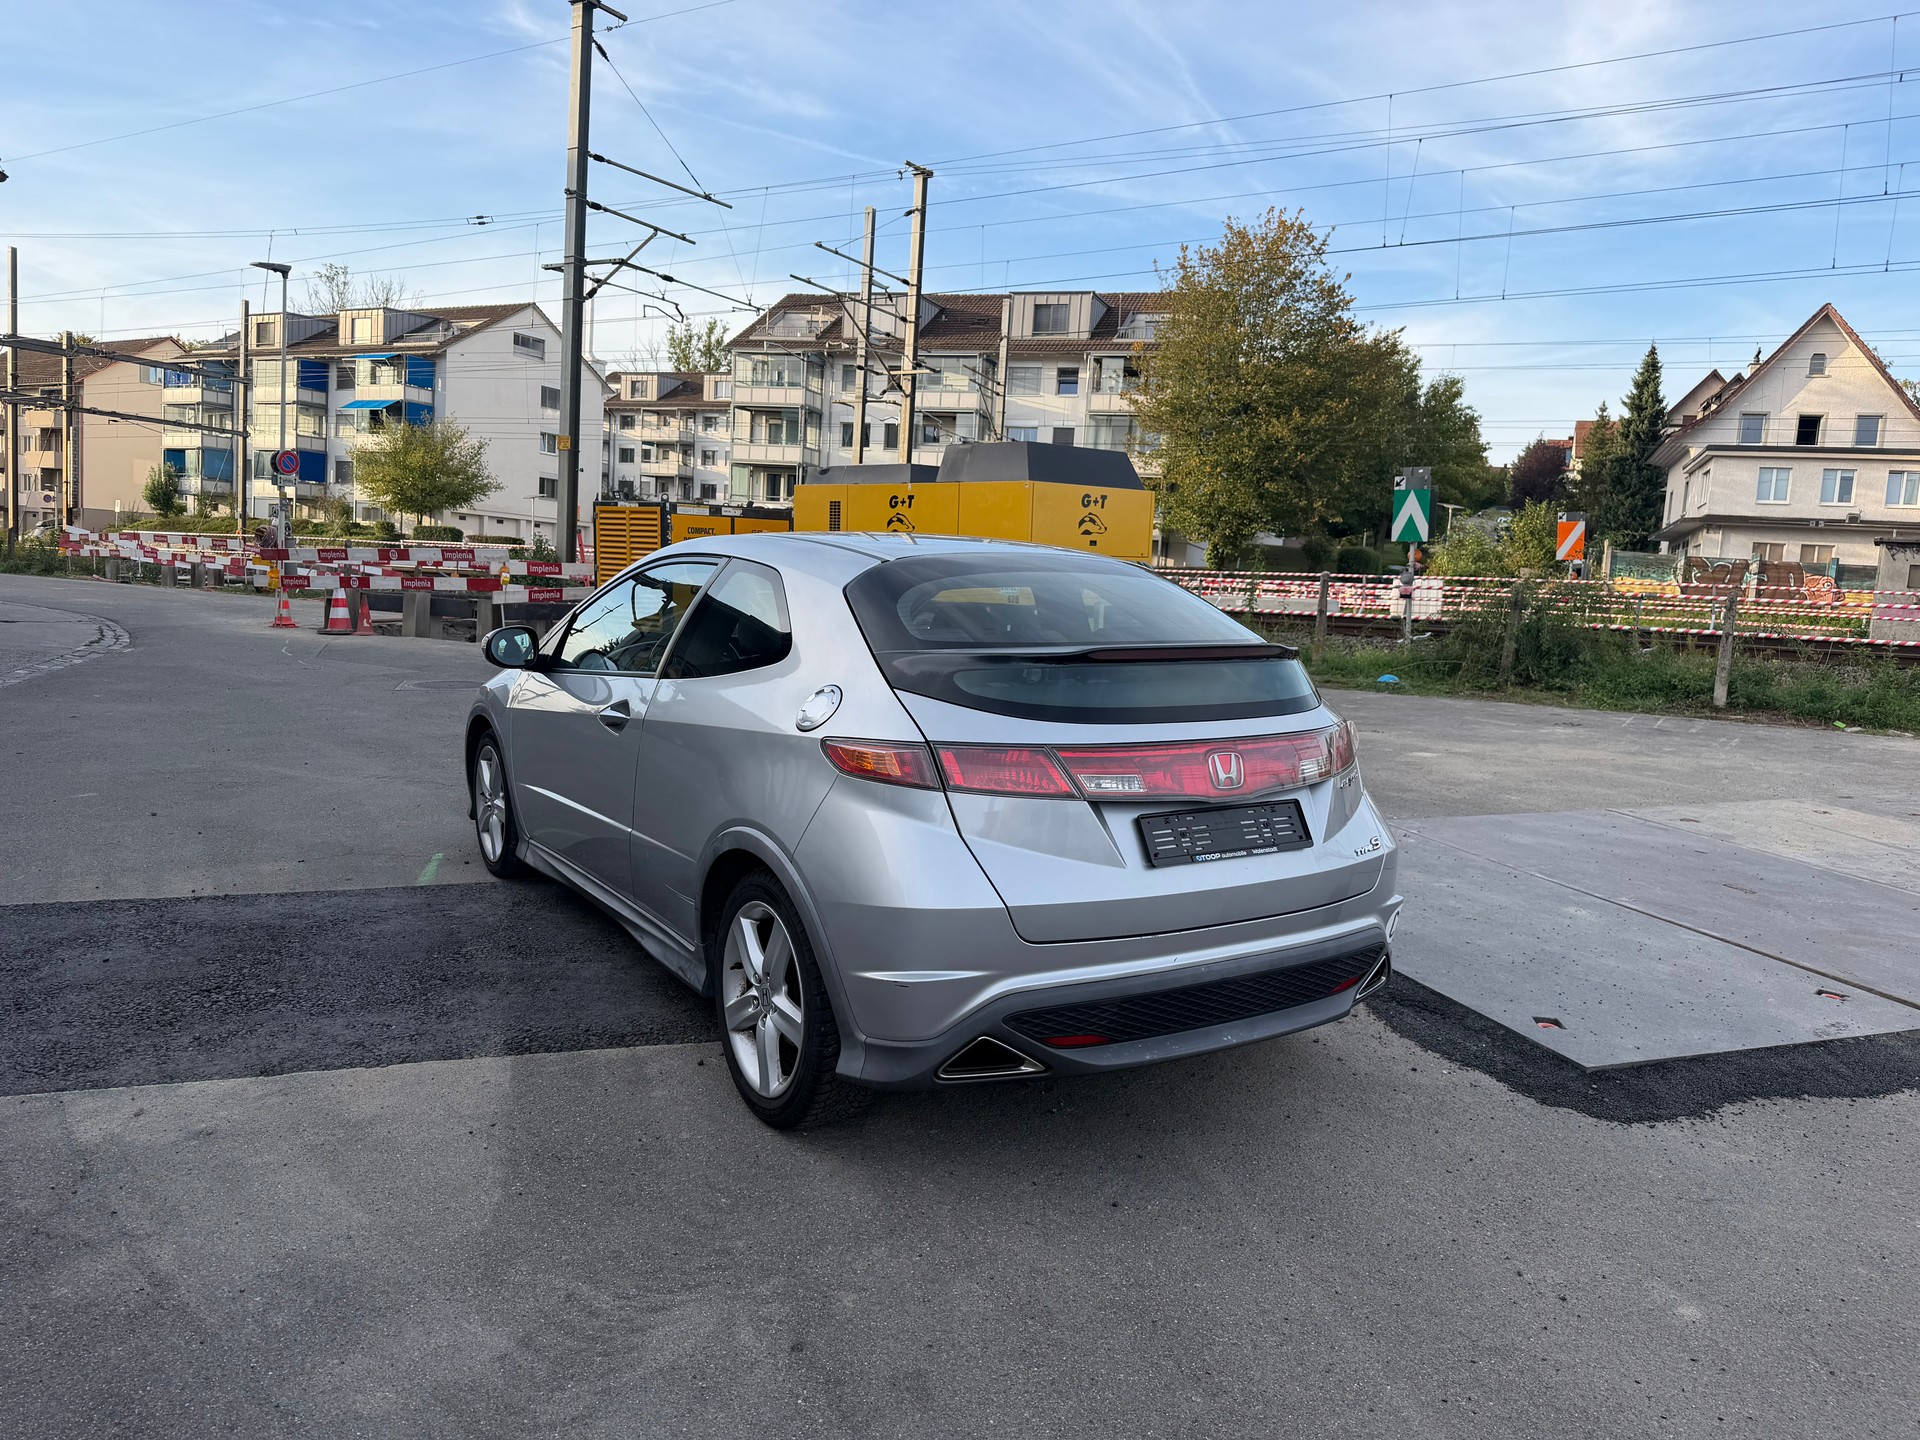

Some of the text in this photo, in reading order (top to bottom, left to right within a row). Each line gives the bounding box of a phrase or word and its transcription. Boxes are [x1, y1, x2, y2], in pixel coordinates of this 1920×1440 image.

[889, 495, 915, 509] G+T
[1081, 493, 1108, 509] G+T
[320, 550, 345, 559] Implenia
[443, 551, 473, 560] Implenia
[529, 564, 559, 574] Implenia
[283, 577, 308, 587] Implenia
[403, 579, 431, 588] Implenia
[531, 591, 561, 600] Implenia
